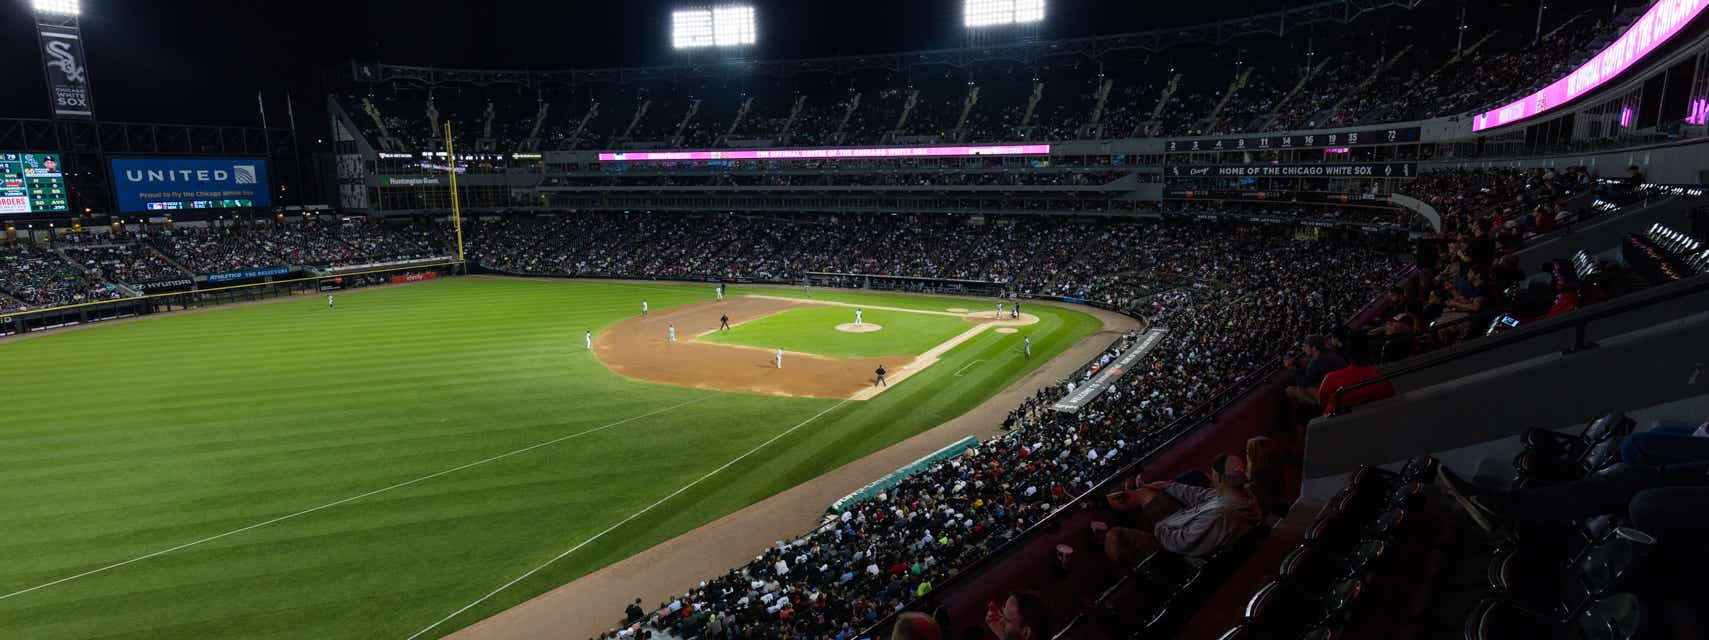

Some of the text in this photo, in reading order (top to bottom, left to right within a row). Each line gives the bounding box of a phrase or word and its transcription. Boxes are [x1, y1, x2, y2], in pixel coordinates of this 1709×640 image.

[58, 98, 86, 106] SOX
[1354, 166, 1372, 175] SOX
[126, 170, 228, 182] UNITED
[210, 273, 242, 281] ATHLETICO
[147, 279, 191, 288] HYUNDAI
